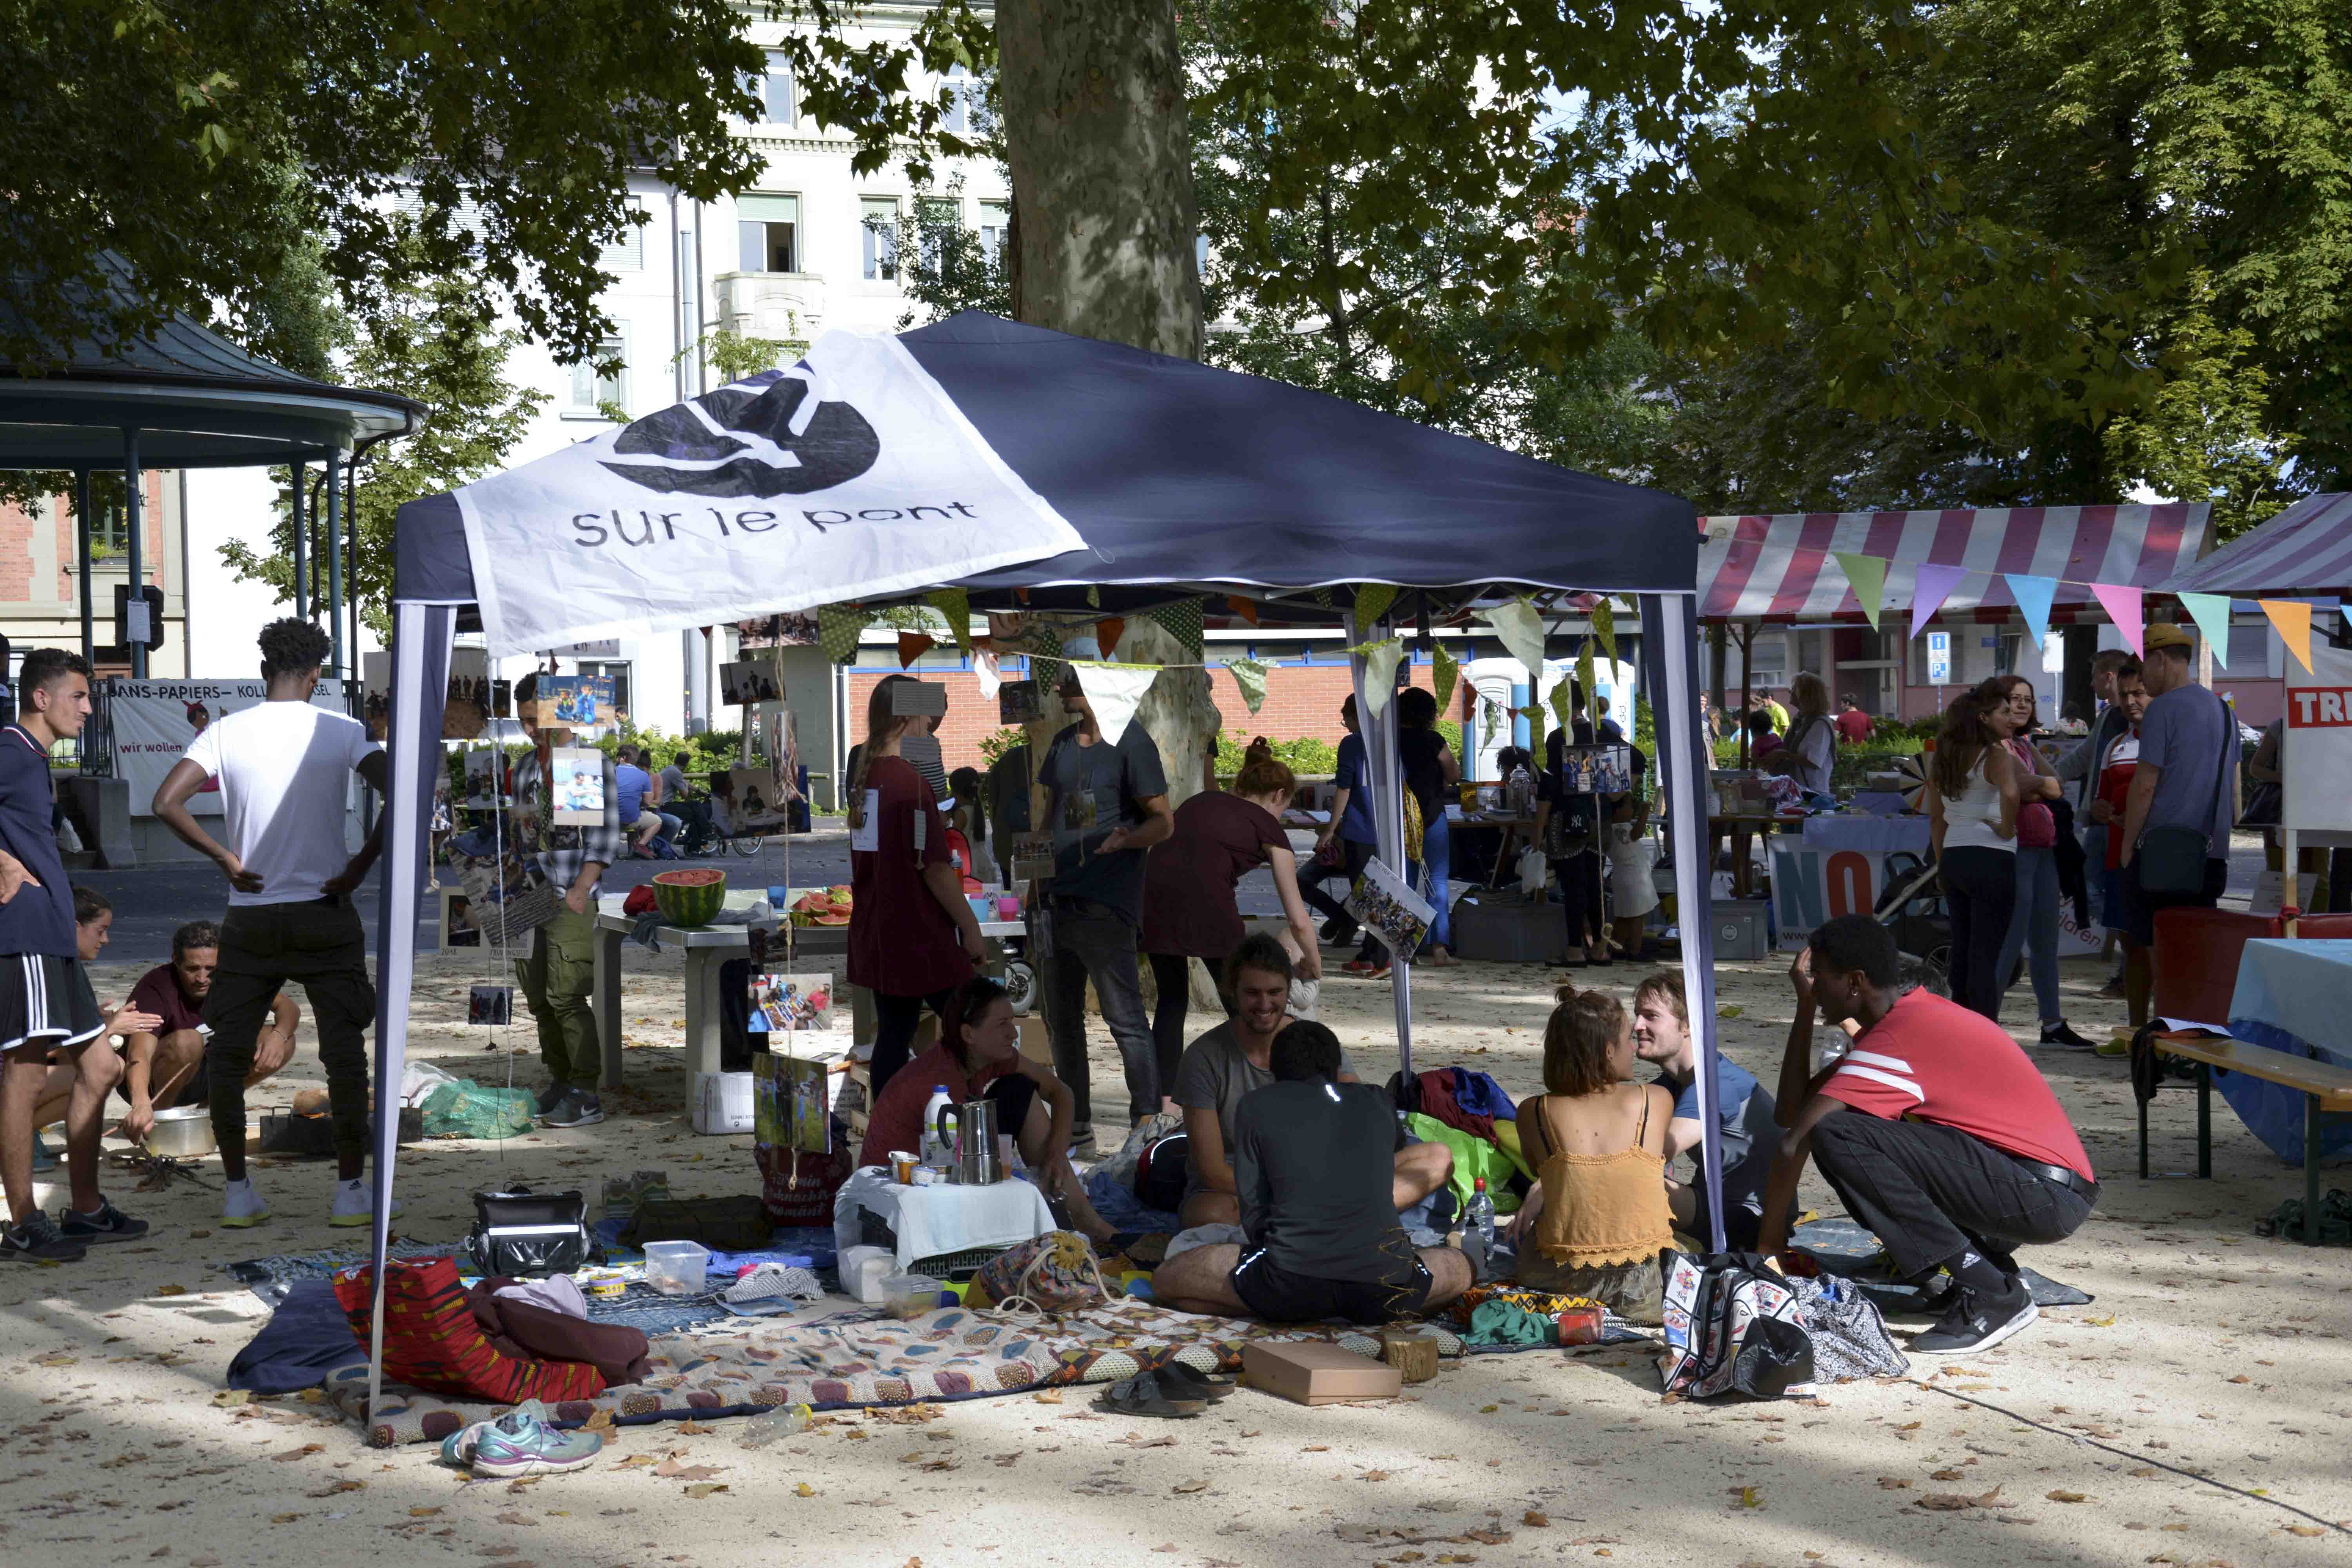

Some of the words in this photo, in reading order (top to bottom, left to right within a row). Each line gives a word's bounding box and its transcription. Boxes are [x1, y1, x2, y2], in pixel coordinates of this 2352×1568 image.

[572, 509, 681, 548] sur
[707, 507, 779, 536] le
[802, 501, 980, 534] pont
[238, 685, 266, 698] KOLL
[120, 743, 141, 753] wir
[145, 742, 183, 753] wollen
